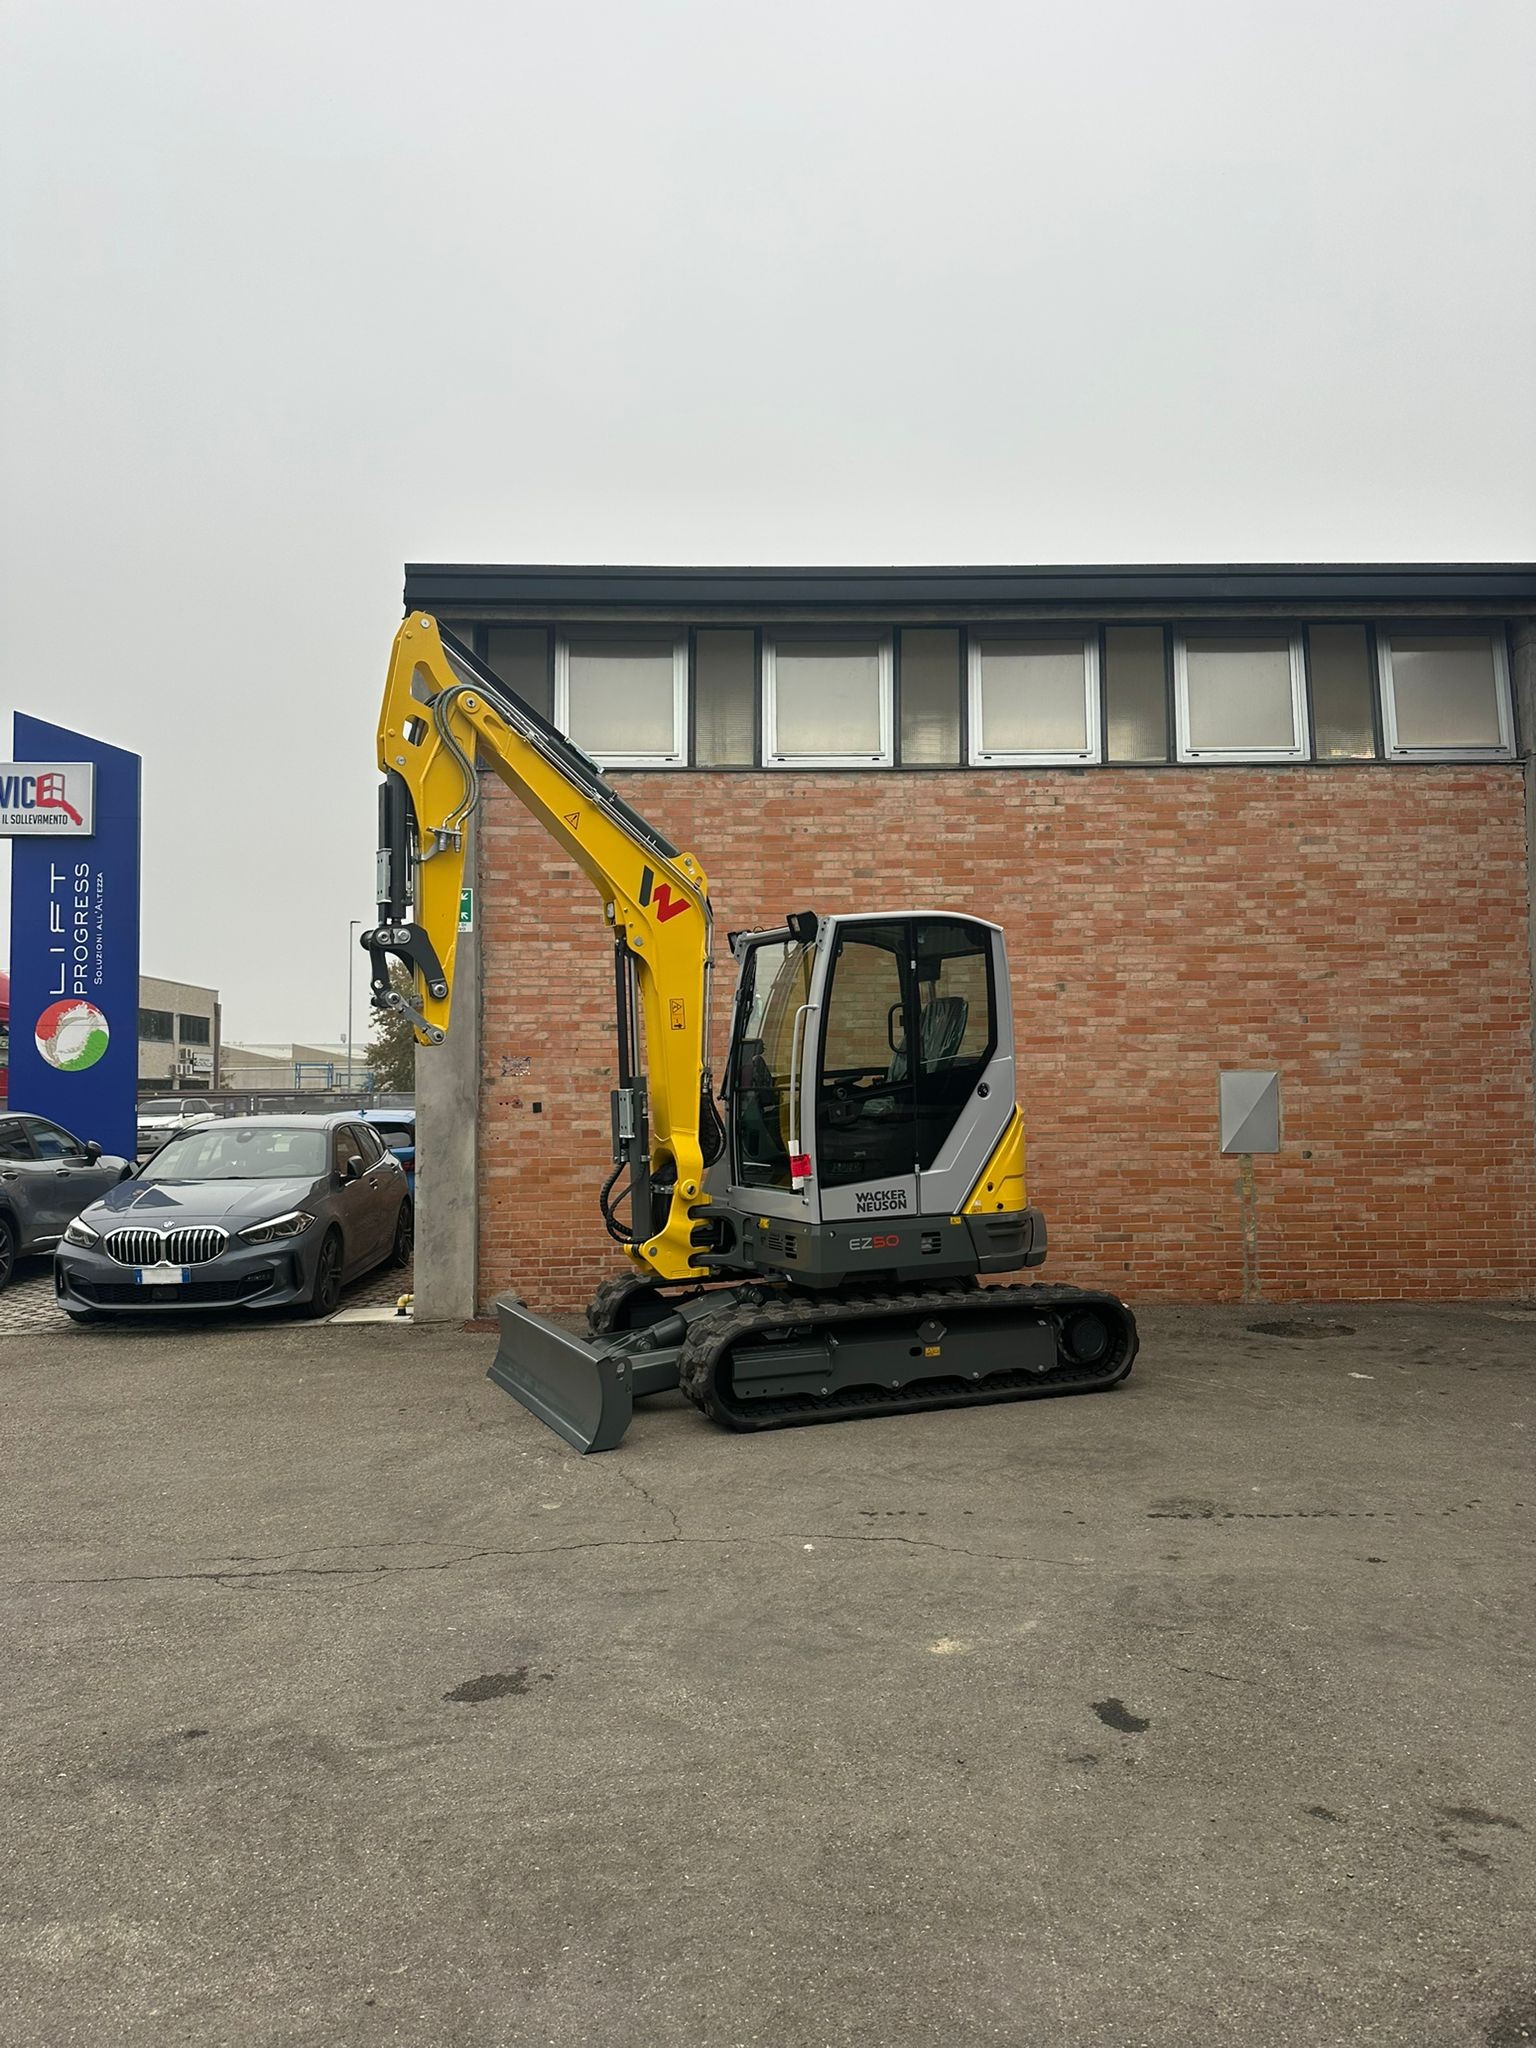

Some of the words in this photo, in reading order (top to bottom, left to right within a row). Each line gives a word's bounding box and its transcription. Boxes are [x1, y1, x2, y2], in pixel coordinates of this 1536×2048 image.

[2, 814, 9, 825] IL
[10, 814, 68, 825] SOLLEVAMENTO
[50, 862, 66, 995] LIFT
[73, 863, 89, 994] PROGRESS
[855, 1189, 906, 1203] WACKER
[856, 1199, 907, 1213] NEUSON
